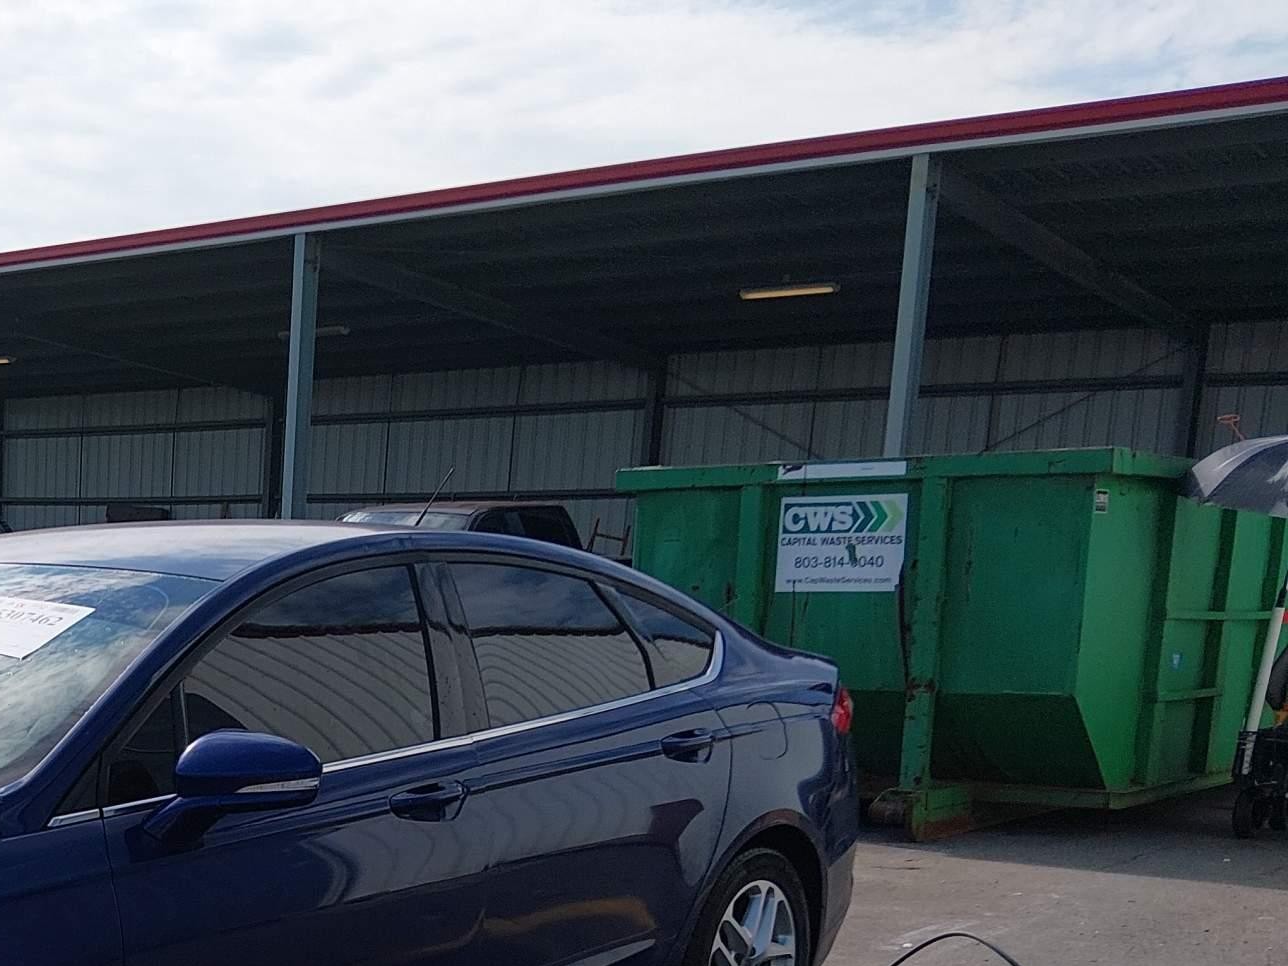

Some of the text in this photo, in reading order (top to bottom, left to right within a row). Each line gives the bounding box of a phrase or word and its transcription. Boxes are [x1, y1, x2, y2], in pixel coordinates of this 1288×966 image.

[784, 505, 854, 532] CWS
[780, 535, 903, 547] CAPITAL WASTE SERVICES
